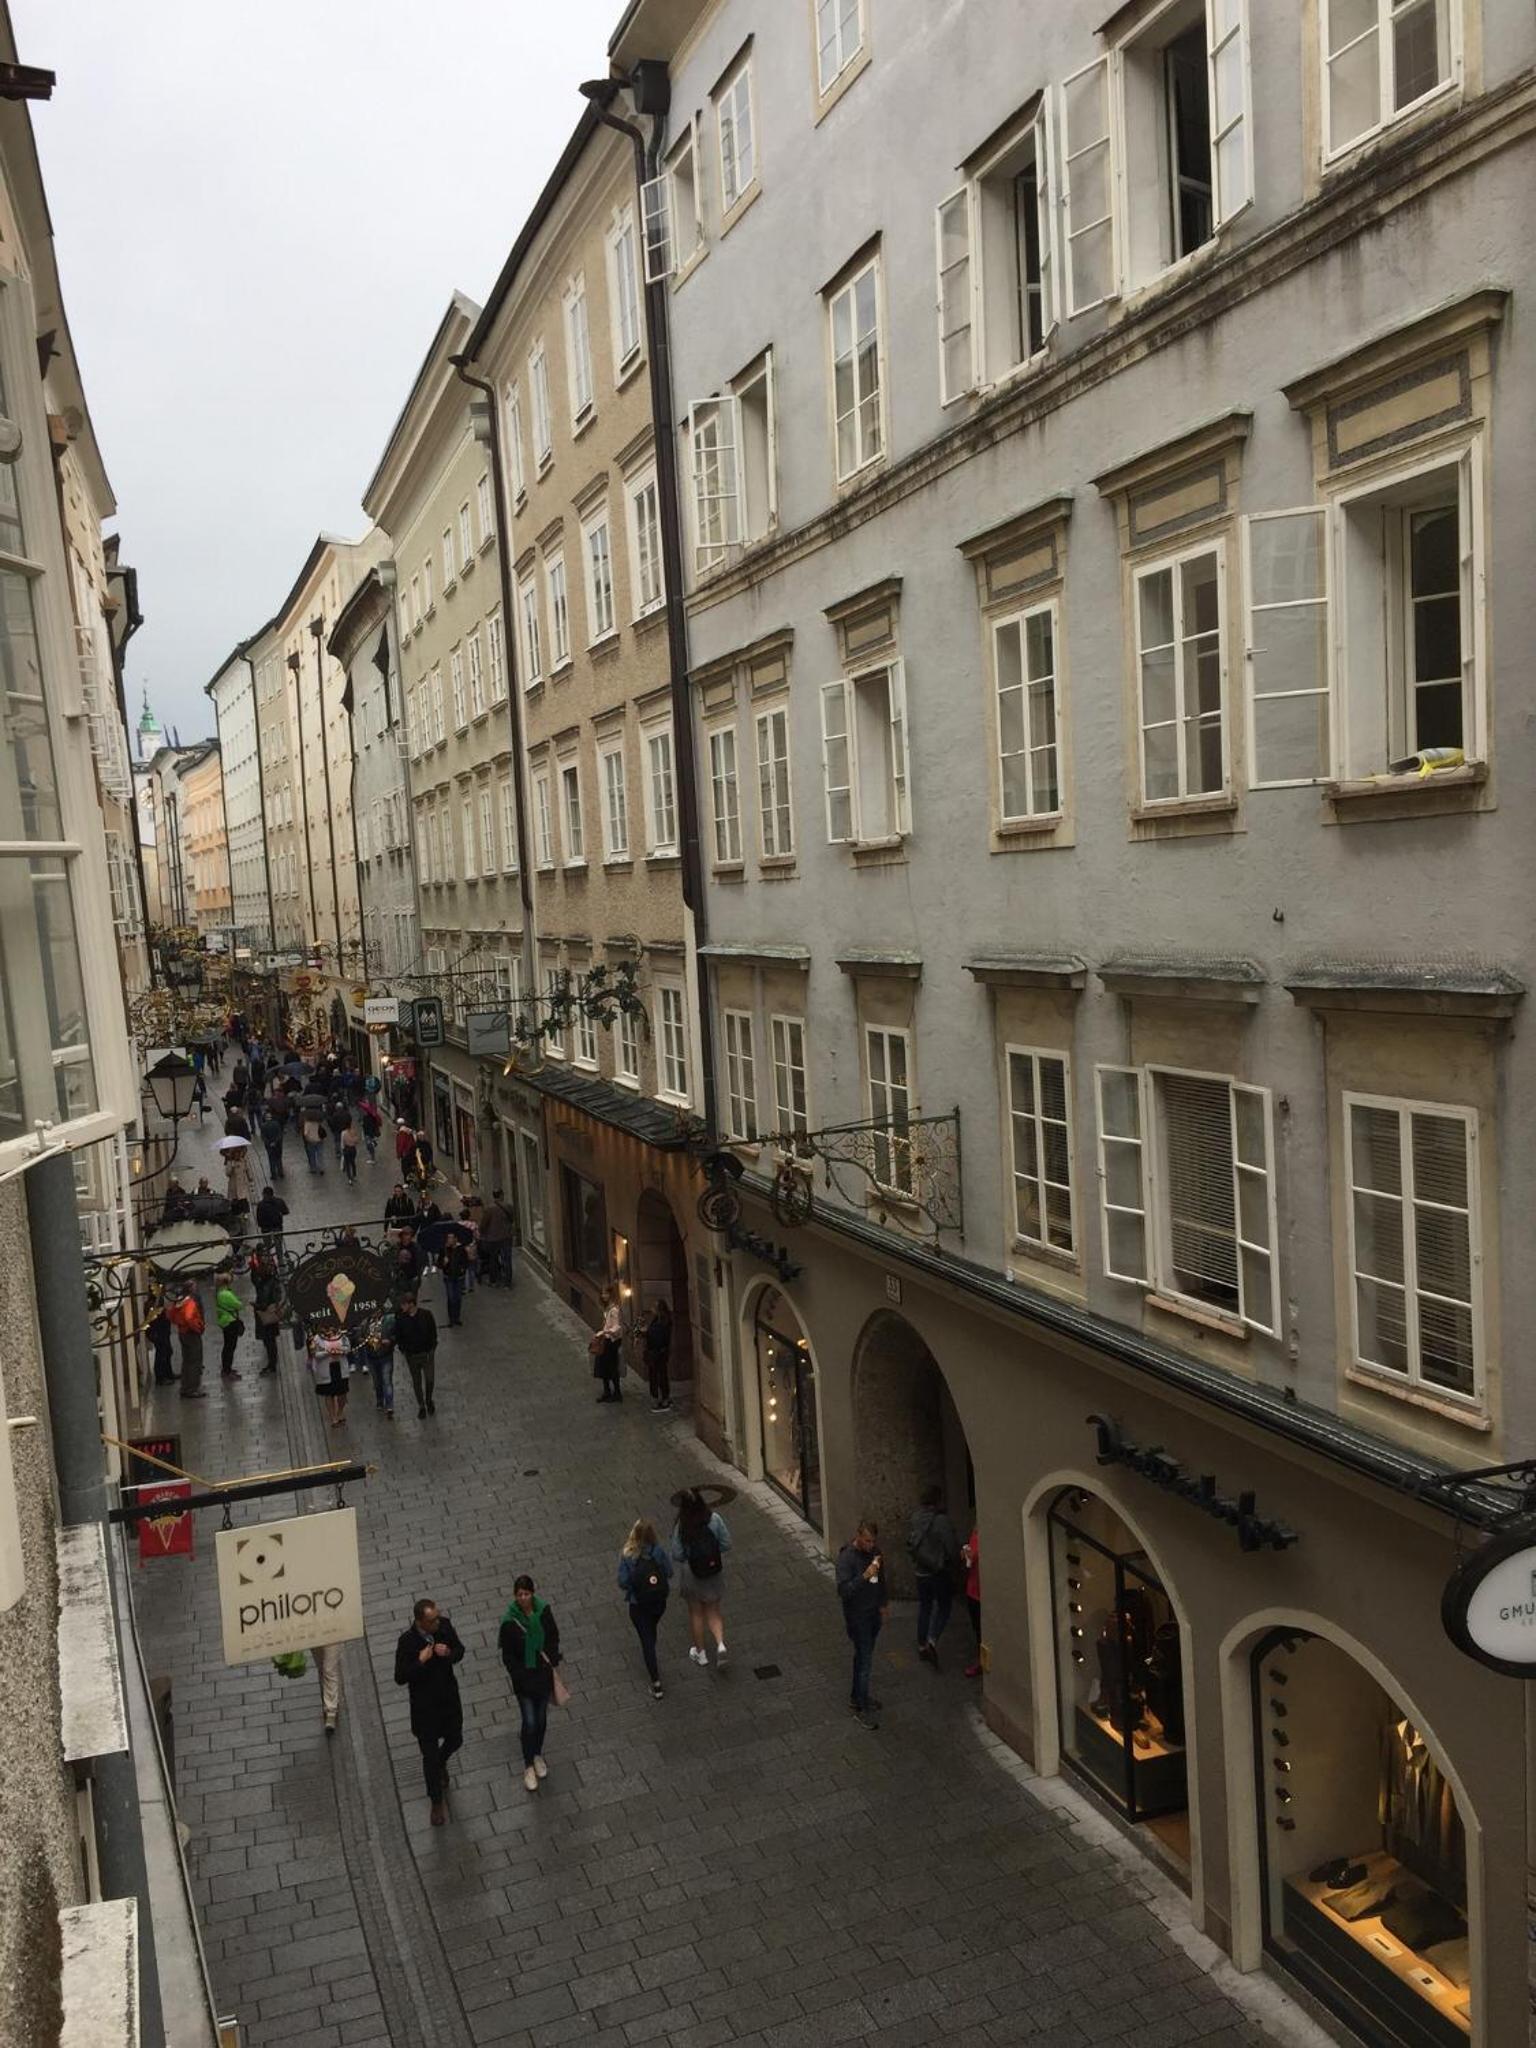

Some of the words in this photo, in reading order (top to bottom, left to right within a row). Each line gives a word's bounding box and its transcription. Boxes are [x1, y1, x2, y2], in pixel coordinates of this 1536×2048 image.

[309, 1308, 331, 1319] seit
[354, 1299, 377, 1312] 1958
[240, 1587, 344, 1634] philoro
